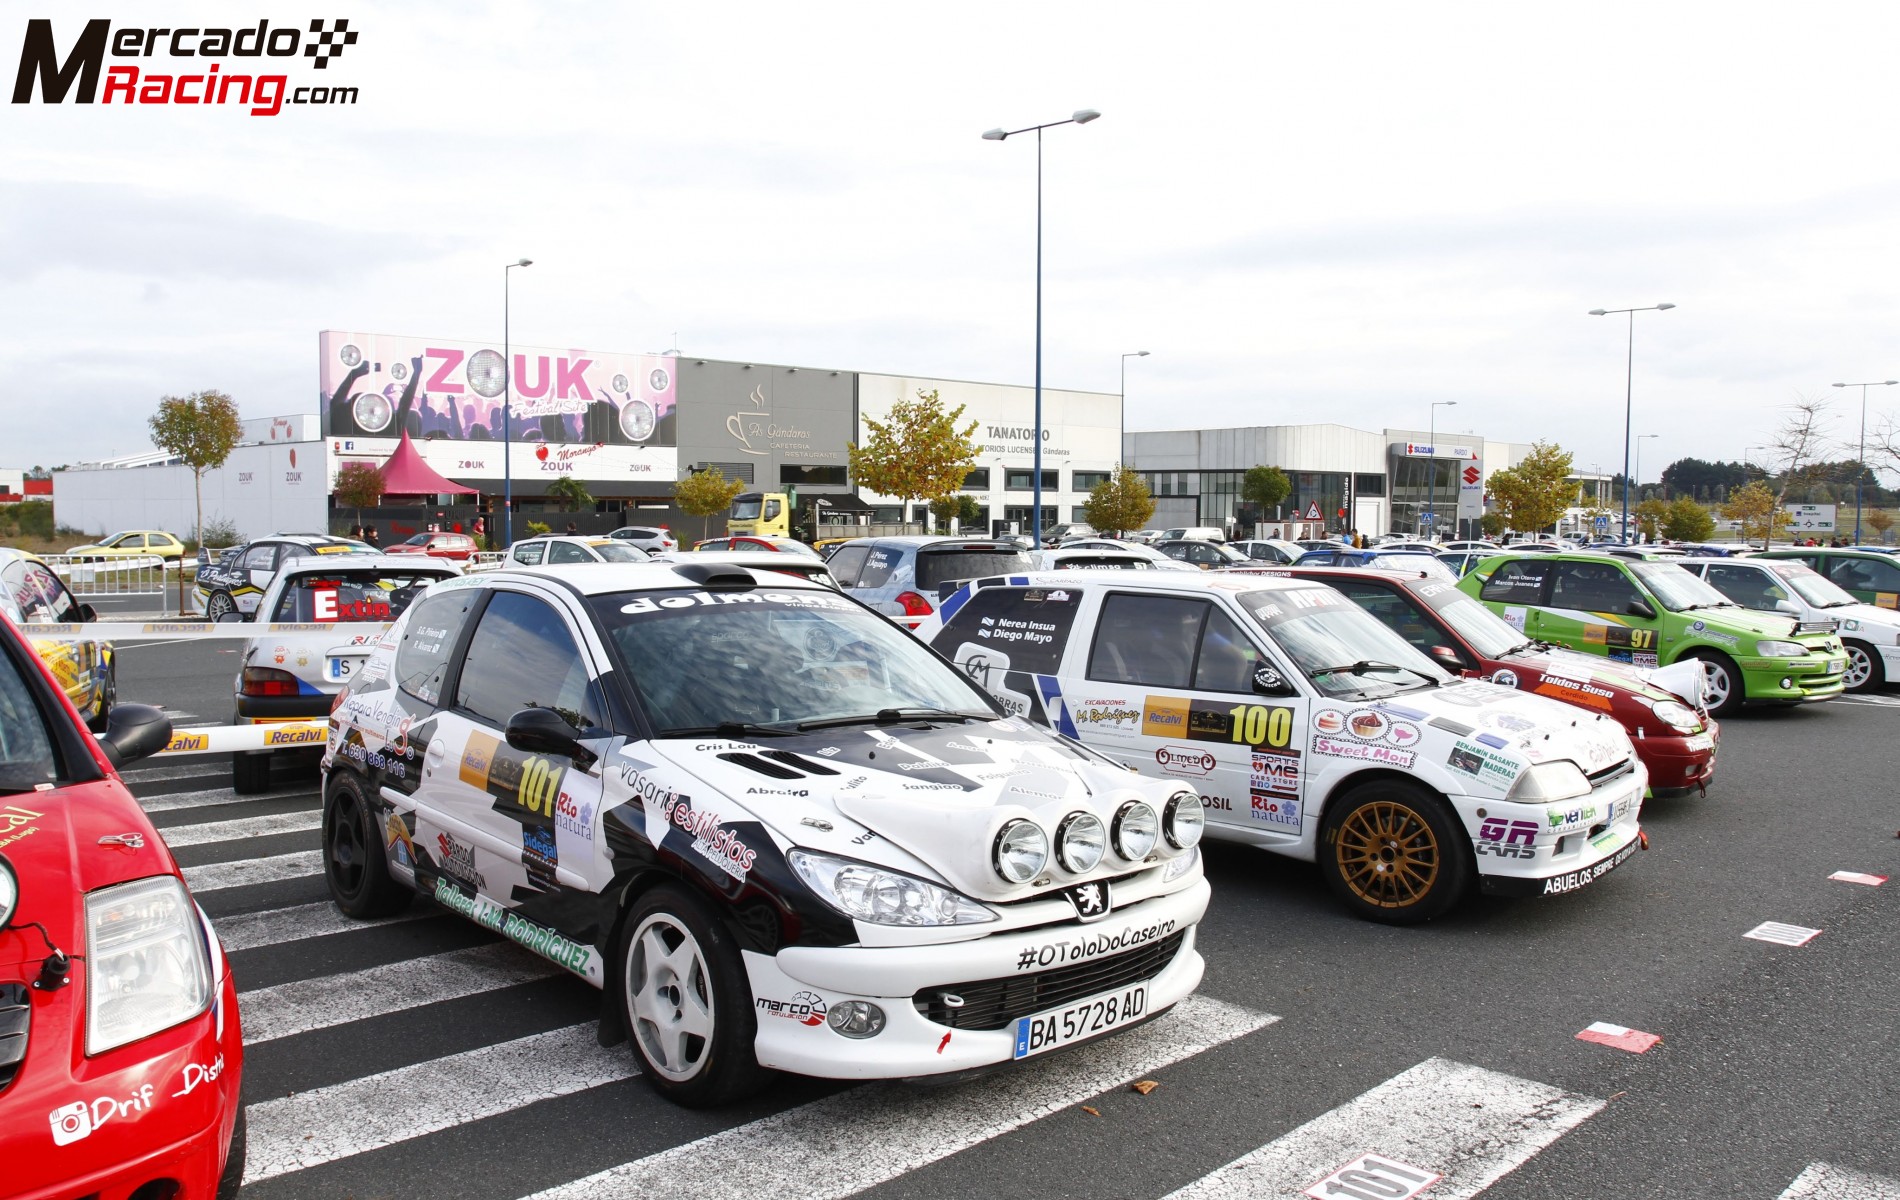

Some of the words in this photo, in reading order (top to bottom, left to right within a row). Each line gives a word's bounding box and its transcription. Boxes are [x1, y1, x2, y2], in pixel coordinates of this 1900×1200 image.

[425, 347, 597, 400] ZOUK
[1414, 446, 1434, 454] SUZUKI
[458, 460, 484, 469] ZOUK
[541, 462, 573, 471] ZOUK
[239, 473, 252, 481] ZOUK
[286, 472, 301, 481] ZOUK
[315, 590, 390, 619] Extin
[998, 618, 1027, 628] Nerea
[1028, 621, 1056, 631] Insua
[993, 629, 1022, 641] Diego
[1024, 632, 1053, 644] Mayo
[1631, 629, 1652, 648] 97
[341, 660, 350, 674] S
[1539, 673, 1580, 690] Toldos
[1581, 684, 1614, 699] Suso
[1149, 712, 1183, 725] Recalvi
[1229, 705, 1292, 748] 100
[271, 729, 322, 743] Recalvi
[348, 742, 366, 760] 630
[367, 751, 385, 769] 868
[387, 759, 405, 778] 116
[1156, 748, 1216, 771] OLMEDO
[1252, 754, 1299, 766] SPORTS
[1318, 740, 1369, 757] Sweet
[1373, 749, 1408, 764] Mon
[1456, 741, 1488, 757] BENJAMÍN
[1489, 754, 1519, 770] BASANTE
[1251, 774, 1270, 782] CARS
[1273, 777, 1298, 785] STORE
[1483, 761, 1516, 779] MADERAS
[518, 756, 563, 818] 101
[620, 761, 673, 809] vasari
[746, 787, 799, 797] Abraira
[557, 792, 577, 818] Rio
[1251, 796, 1278, 812] Rio
[555, 813, 592, 840] natura
[1251, 810, 1299, 826] natura
[674, 800, 757, 870] estilistas
[1479, 818, 1539, 845] GR
[524, 832, 557, 860] Sidegal
[1475, 840, 1537, 859] CARS
[1544, 869, 1592, 894] ABUELOS,
[1593, 857, 1614, 877] SIEMPRE
[503, 913, 591, 976] RODRÍGUEZ
[1017, 918, 1175, 970] #OToloDoCaseiro
[756, 998, 810, 1015] marco
[1030, 1015, 1057, 1050] BA
[1064, 997, 1118, 1039] 5728
[1121, 988, 1145, 1021] AD
[1019, 1042, 1025, 1051] E
[91, 1084, 153, 1130] Drif
[1325, 1158, 1428, 1200] 101
